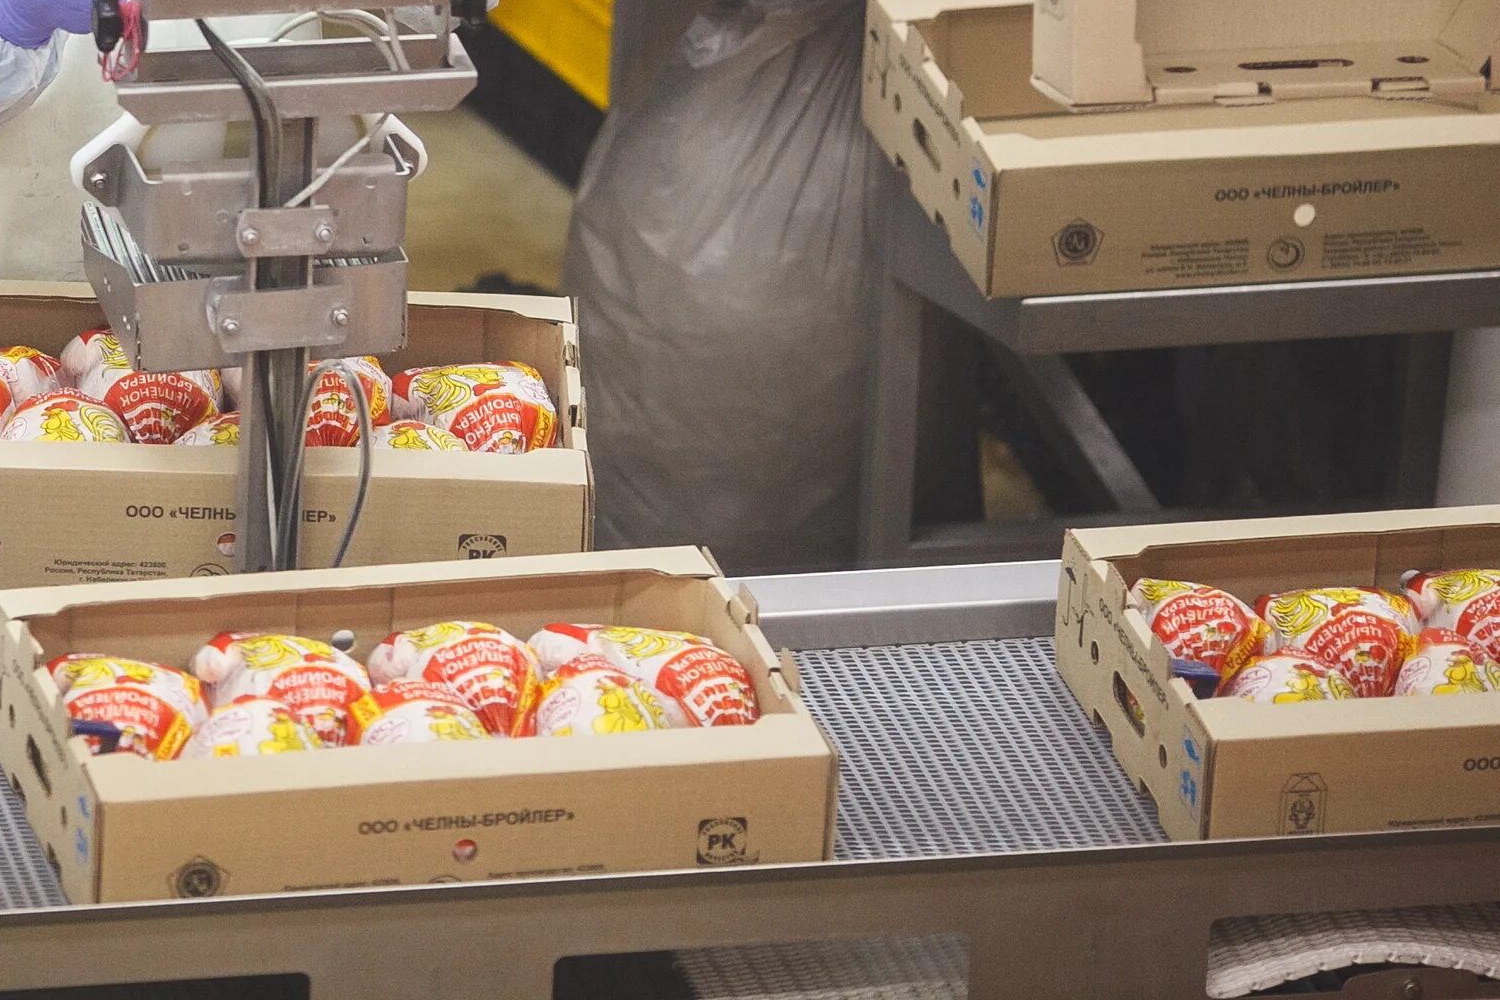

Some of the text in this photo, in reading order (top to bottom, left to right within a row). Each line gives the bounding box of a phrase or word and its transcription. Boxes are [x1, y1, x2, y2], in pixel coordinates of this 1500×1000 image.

[1215, 188, 1249, 201] ООО
[126, 505, 164, 518] ООО
[1464, 757, 1500, 771] ООО
[358, 809, 575, 835] ООО «ЧЕЛНЫ-БРОЙЛЕР»
